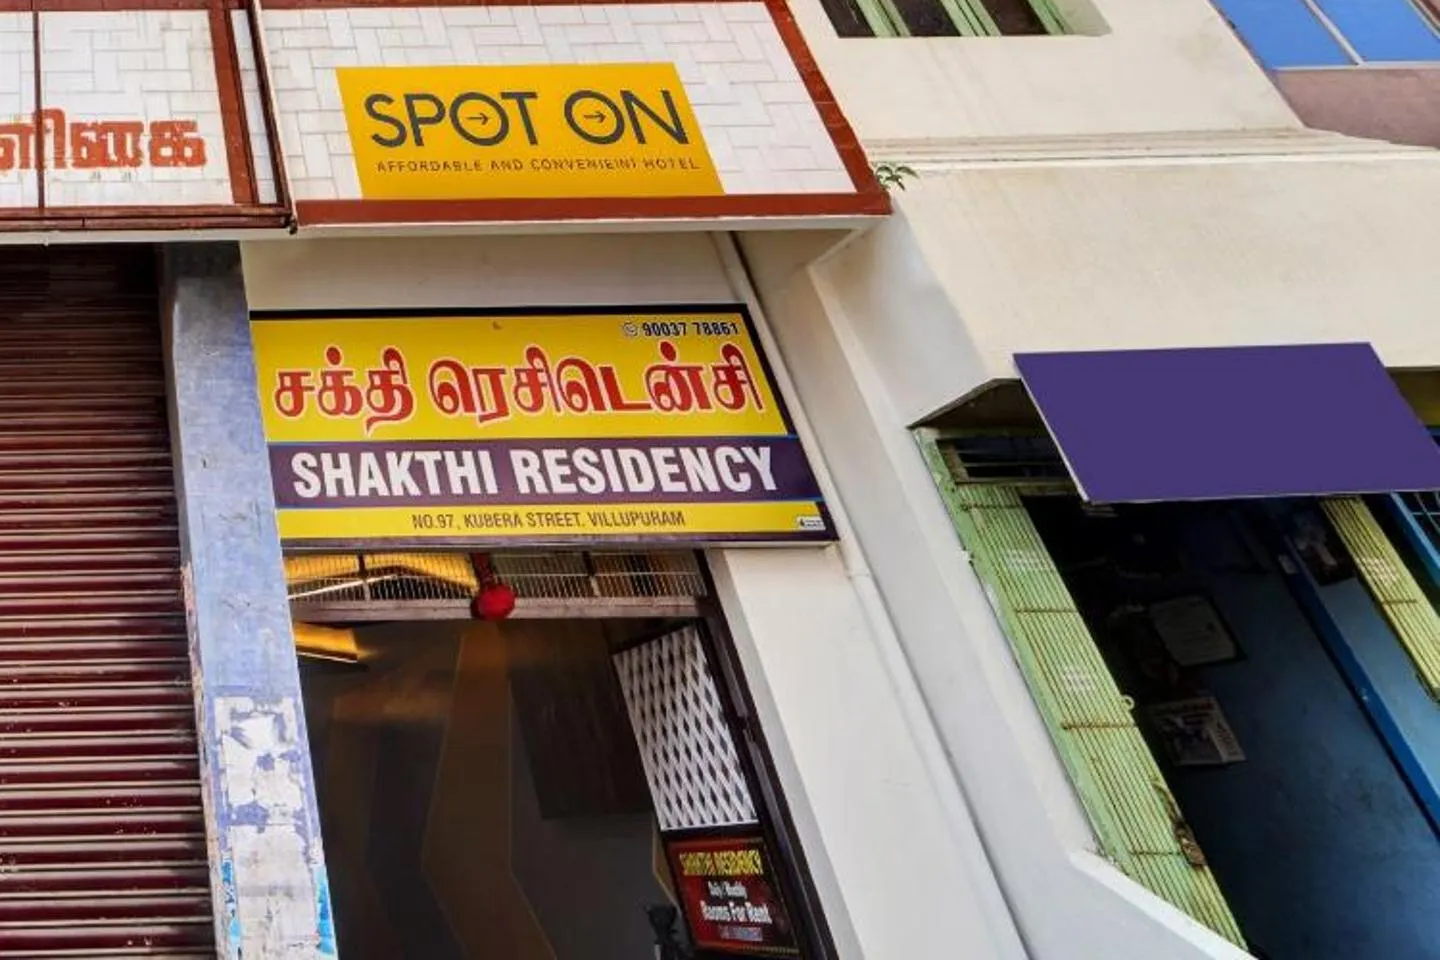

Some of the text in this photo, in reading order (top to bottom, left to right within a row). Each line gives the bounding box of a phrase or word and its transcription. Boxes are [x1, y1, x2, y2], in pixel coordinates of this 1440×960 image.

[364, 89, 690, 148] SPOT ON
[377, 158, 482, 172] AFFORDABLE
[490, 157, 523, 171] AND
[644, 156, 700, 171] HOTEL
[642, 322, 687, 337] 90037
[274, 346, 415, 436] சக்தி
[291, 445, 778, 499] SHAKTHI RESIDENCY
[464, 513, 523, 529] KUBERA
[587, 510, 686, 527] VILLUPURAM
